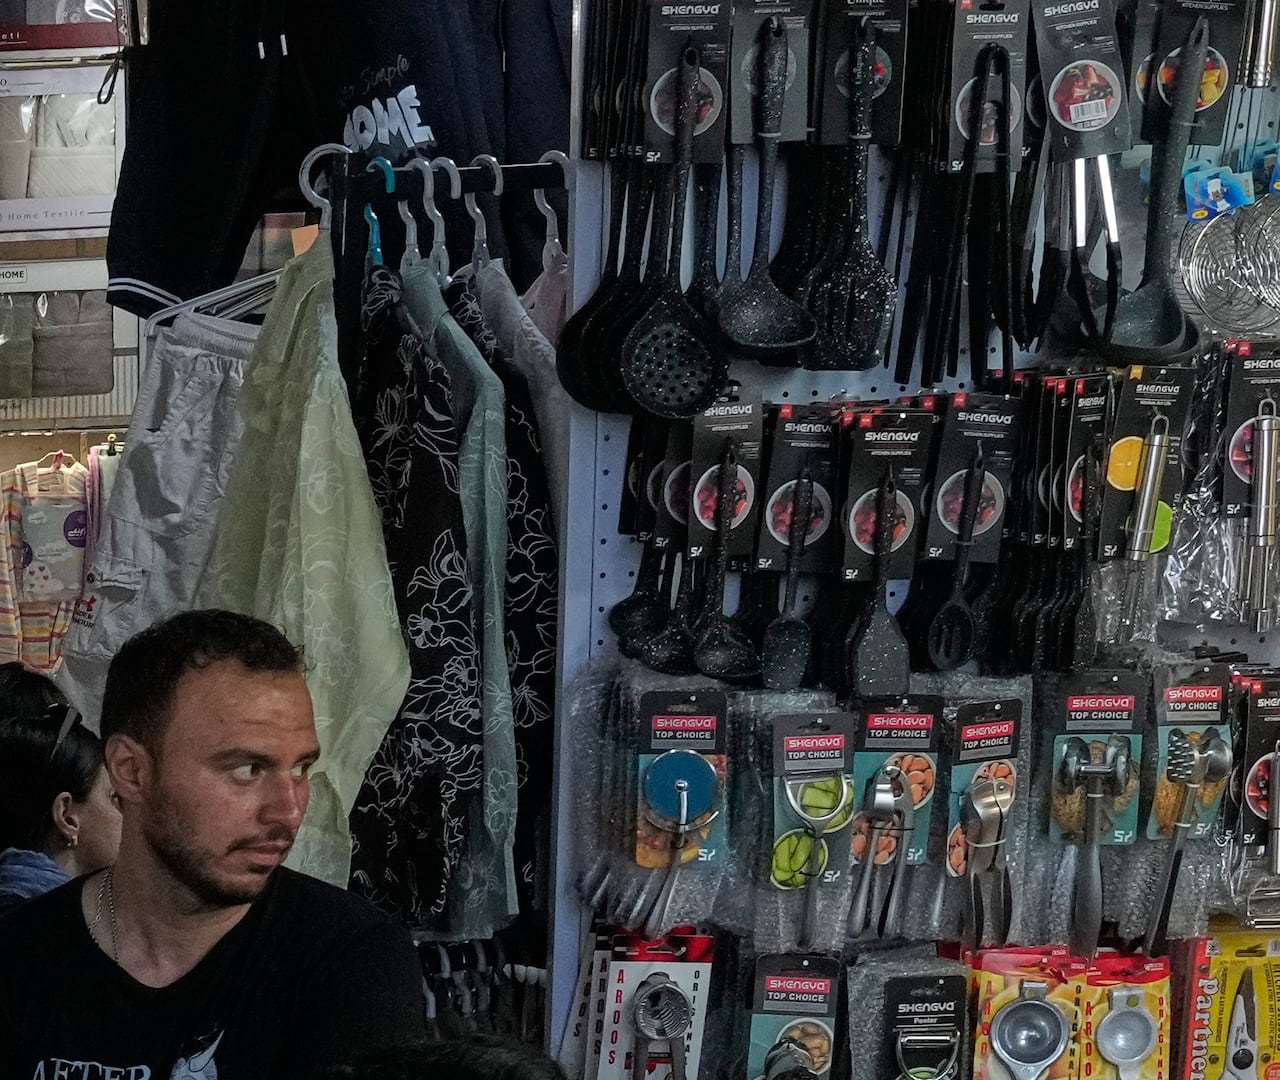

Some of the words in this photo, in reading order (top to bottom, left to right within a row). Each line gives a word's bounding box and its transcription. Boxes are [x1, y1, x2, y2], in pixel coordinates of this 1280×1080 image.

[8, 211, 39, 221] Home
[44, 209, 85, 219] Textile
[0, 268, 25, 280] HOME
[1169, 702, 1184, 710] TOP
[1186, 701, 1218, 710] CHOICE
[1092, 711, 1129, 719] CHOICE
[655, 731, 674, 739] TOP
[676, 731, 711, 739] CHOICE
[870, 730, 887, 738] TOP
[889, 729, 927, 738] CHOICE
[963, 740, 979, 749] TOP
[981, 737, 1009, 747] CHOICE
[788, 751, 805, 759] TOP
[807, 749, 840, 759] CHOICE
[768, 992, 786, 1001] TOP
[789, 993, 825, 1002] CHOICE
[608, 969, 625, 1064] AROOS
